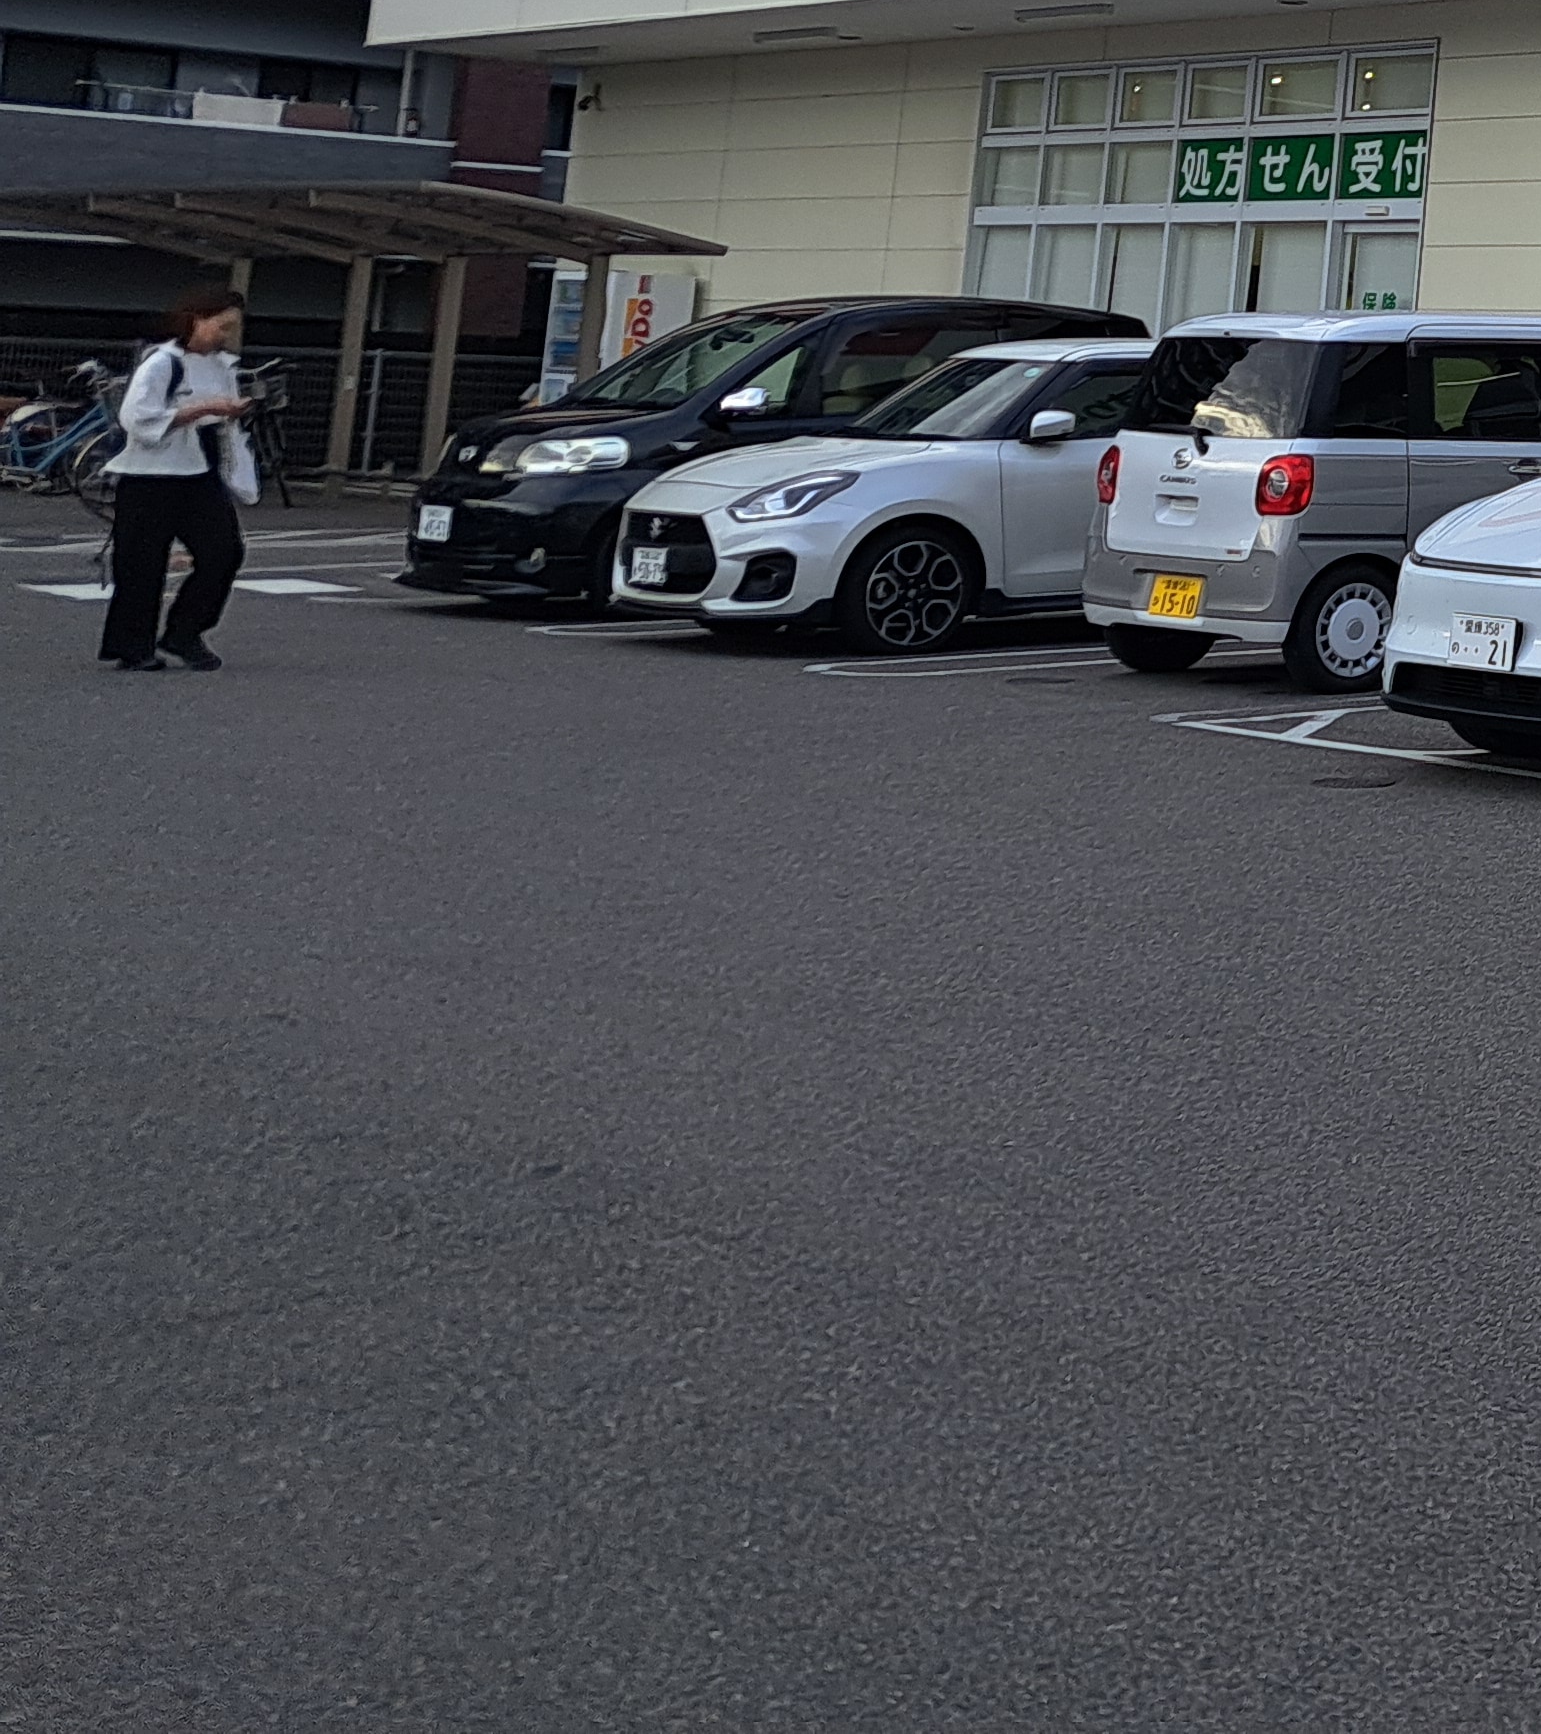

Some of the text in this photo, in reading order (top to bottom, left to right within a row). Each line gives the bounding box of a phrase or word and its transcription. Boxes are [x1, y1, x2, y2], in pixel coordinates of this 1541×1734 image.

[1177, 132, 1427, 203] 処方せん受付
[1362, 291, 1398, 311] 保険
